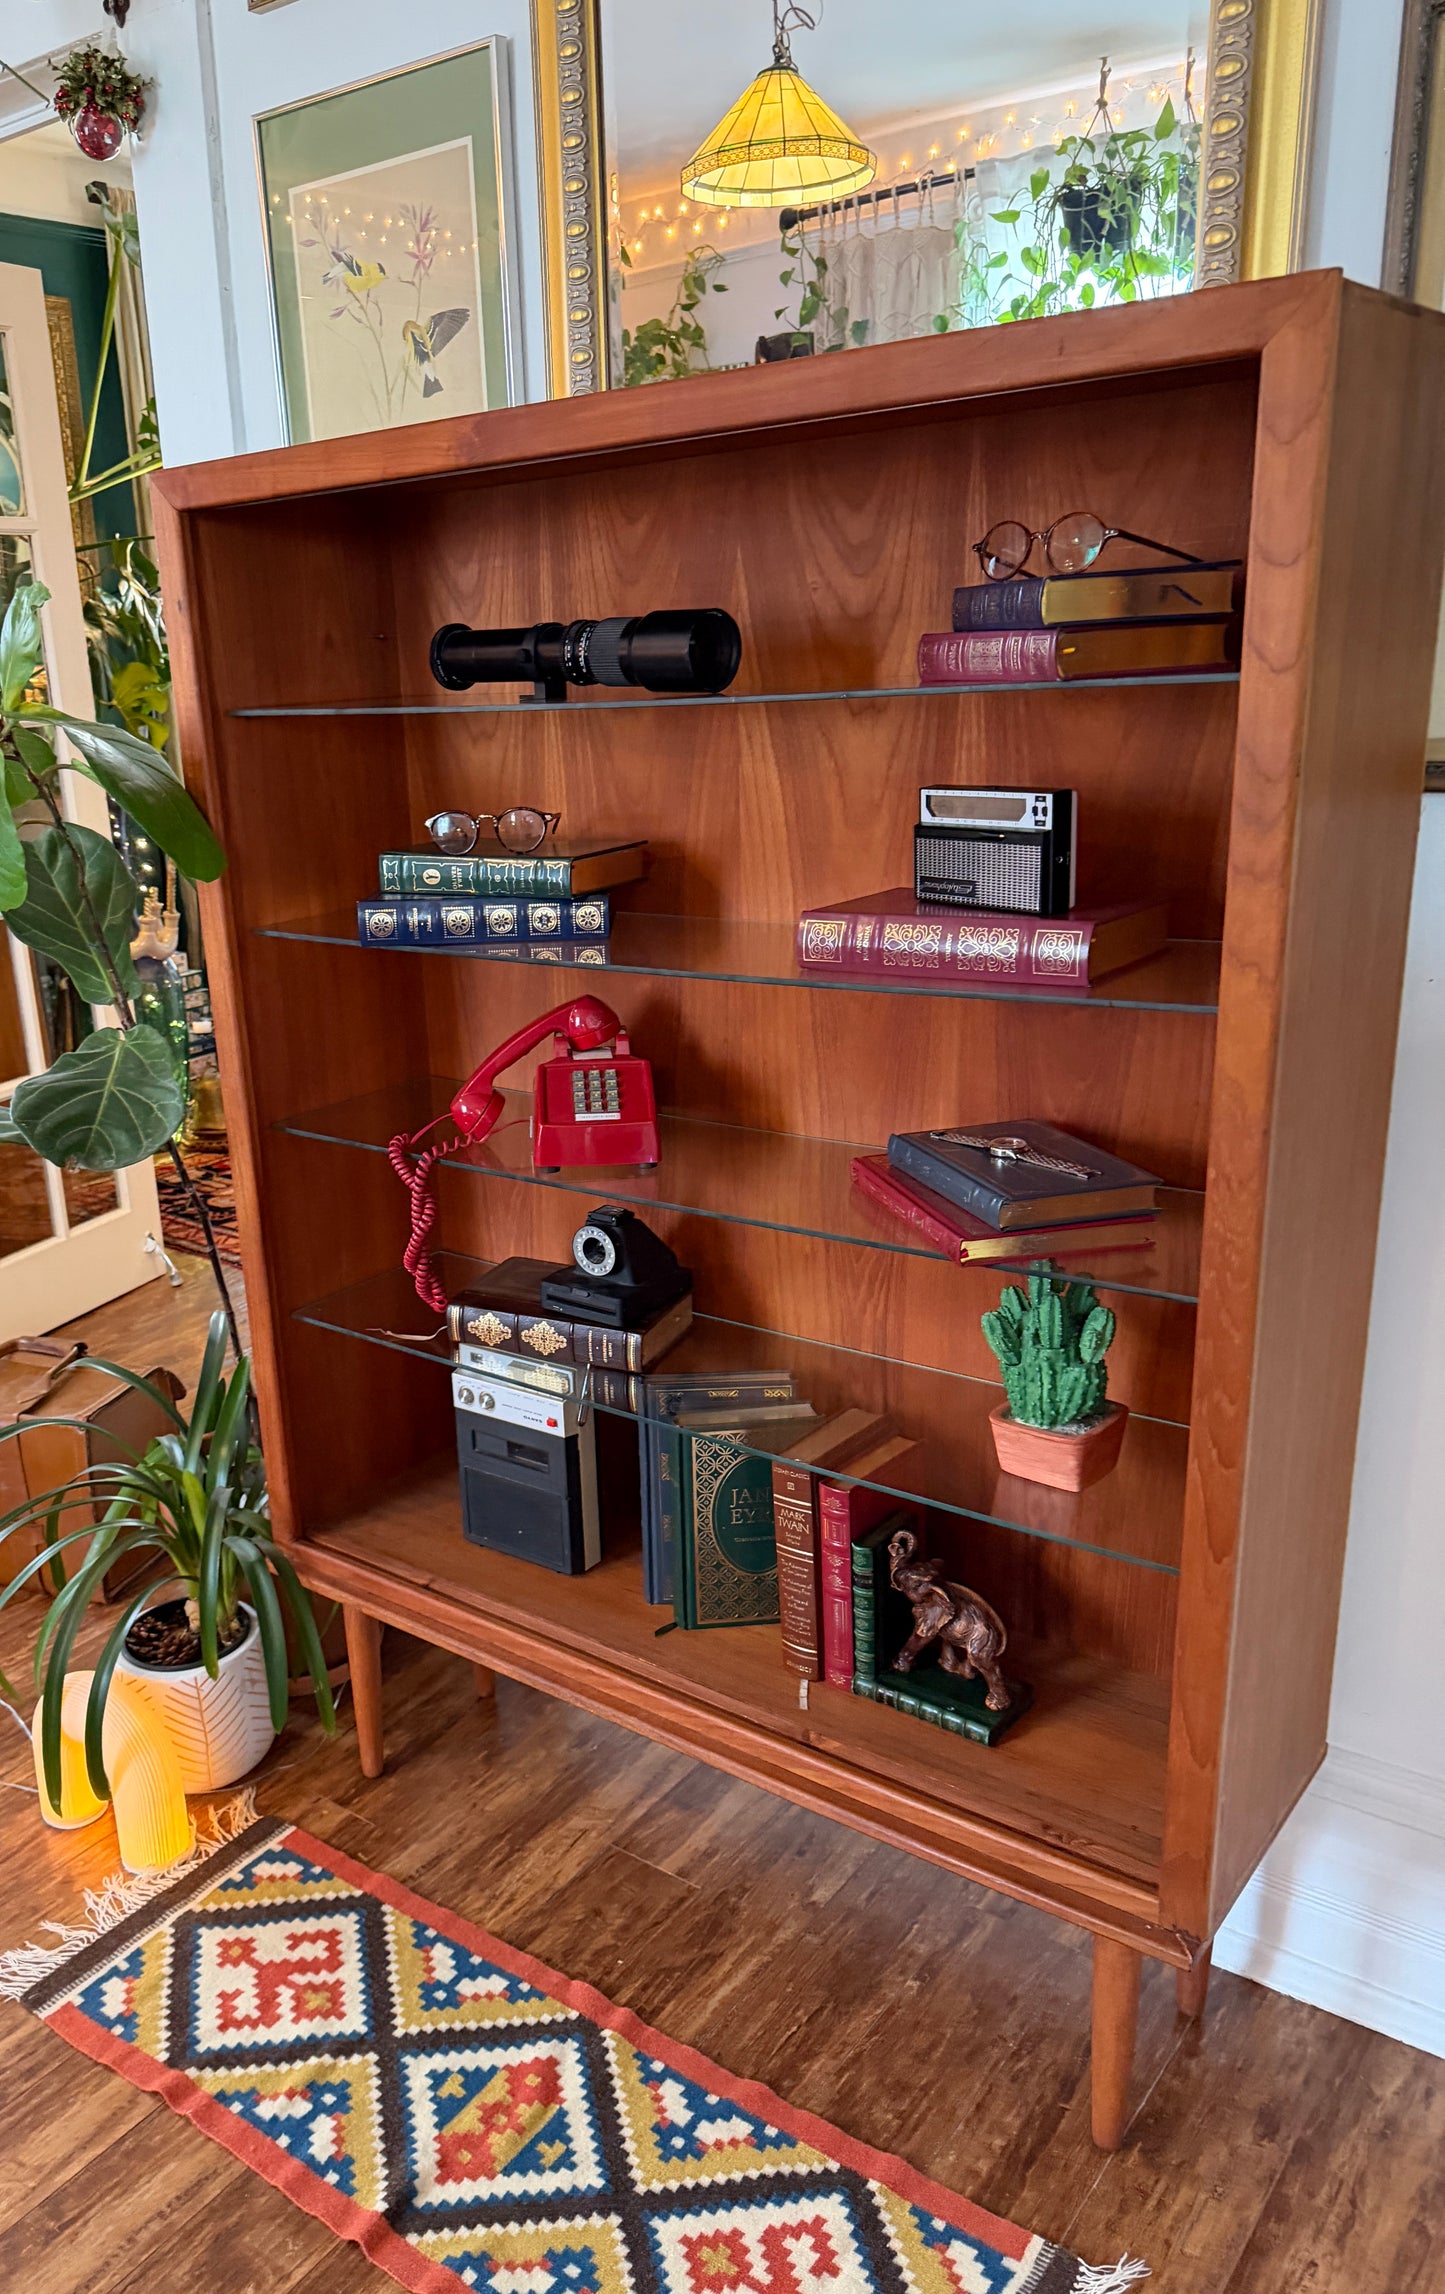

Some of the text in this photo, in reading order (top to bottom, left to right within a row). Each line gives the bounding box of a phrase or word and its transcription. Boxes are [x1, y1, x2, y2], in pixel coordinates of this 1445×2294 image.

[729, 1488, 772, 1508] JAN
[780, 1508, 805, 1522] MARK
[778, 1516, 809, 1535] TWAIN
